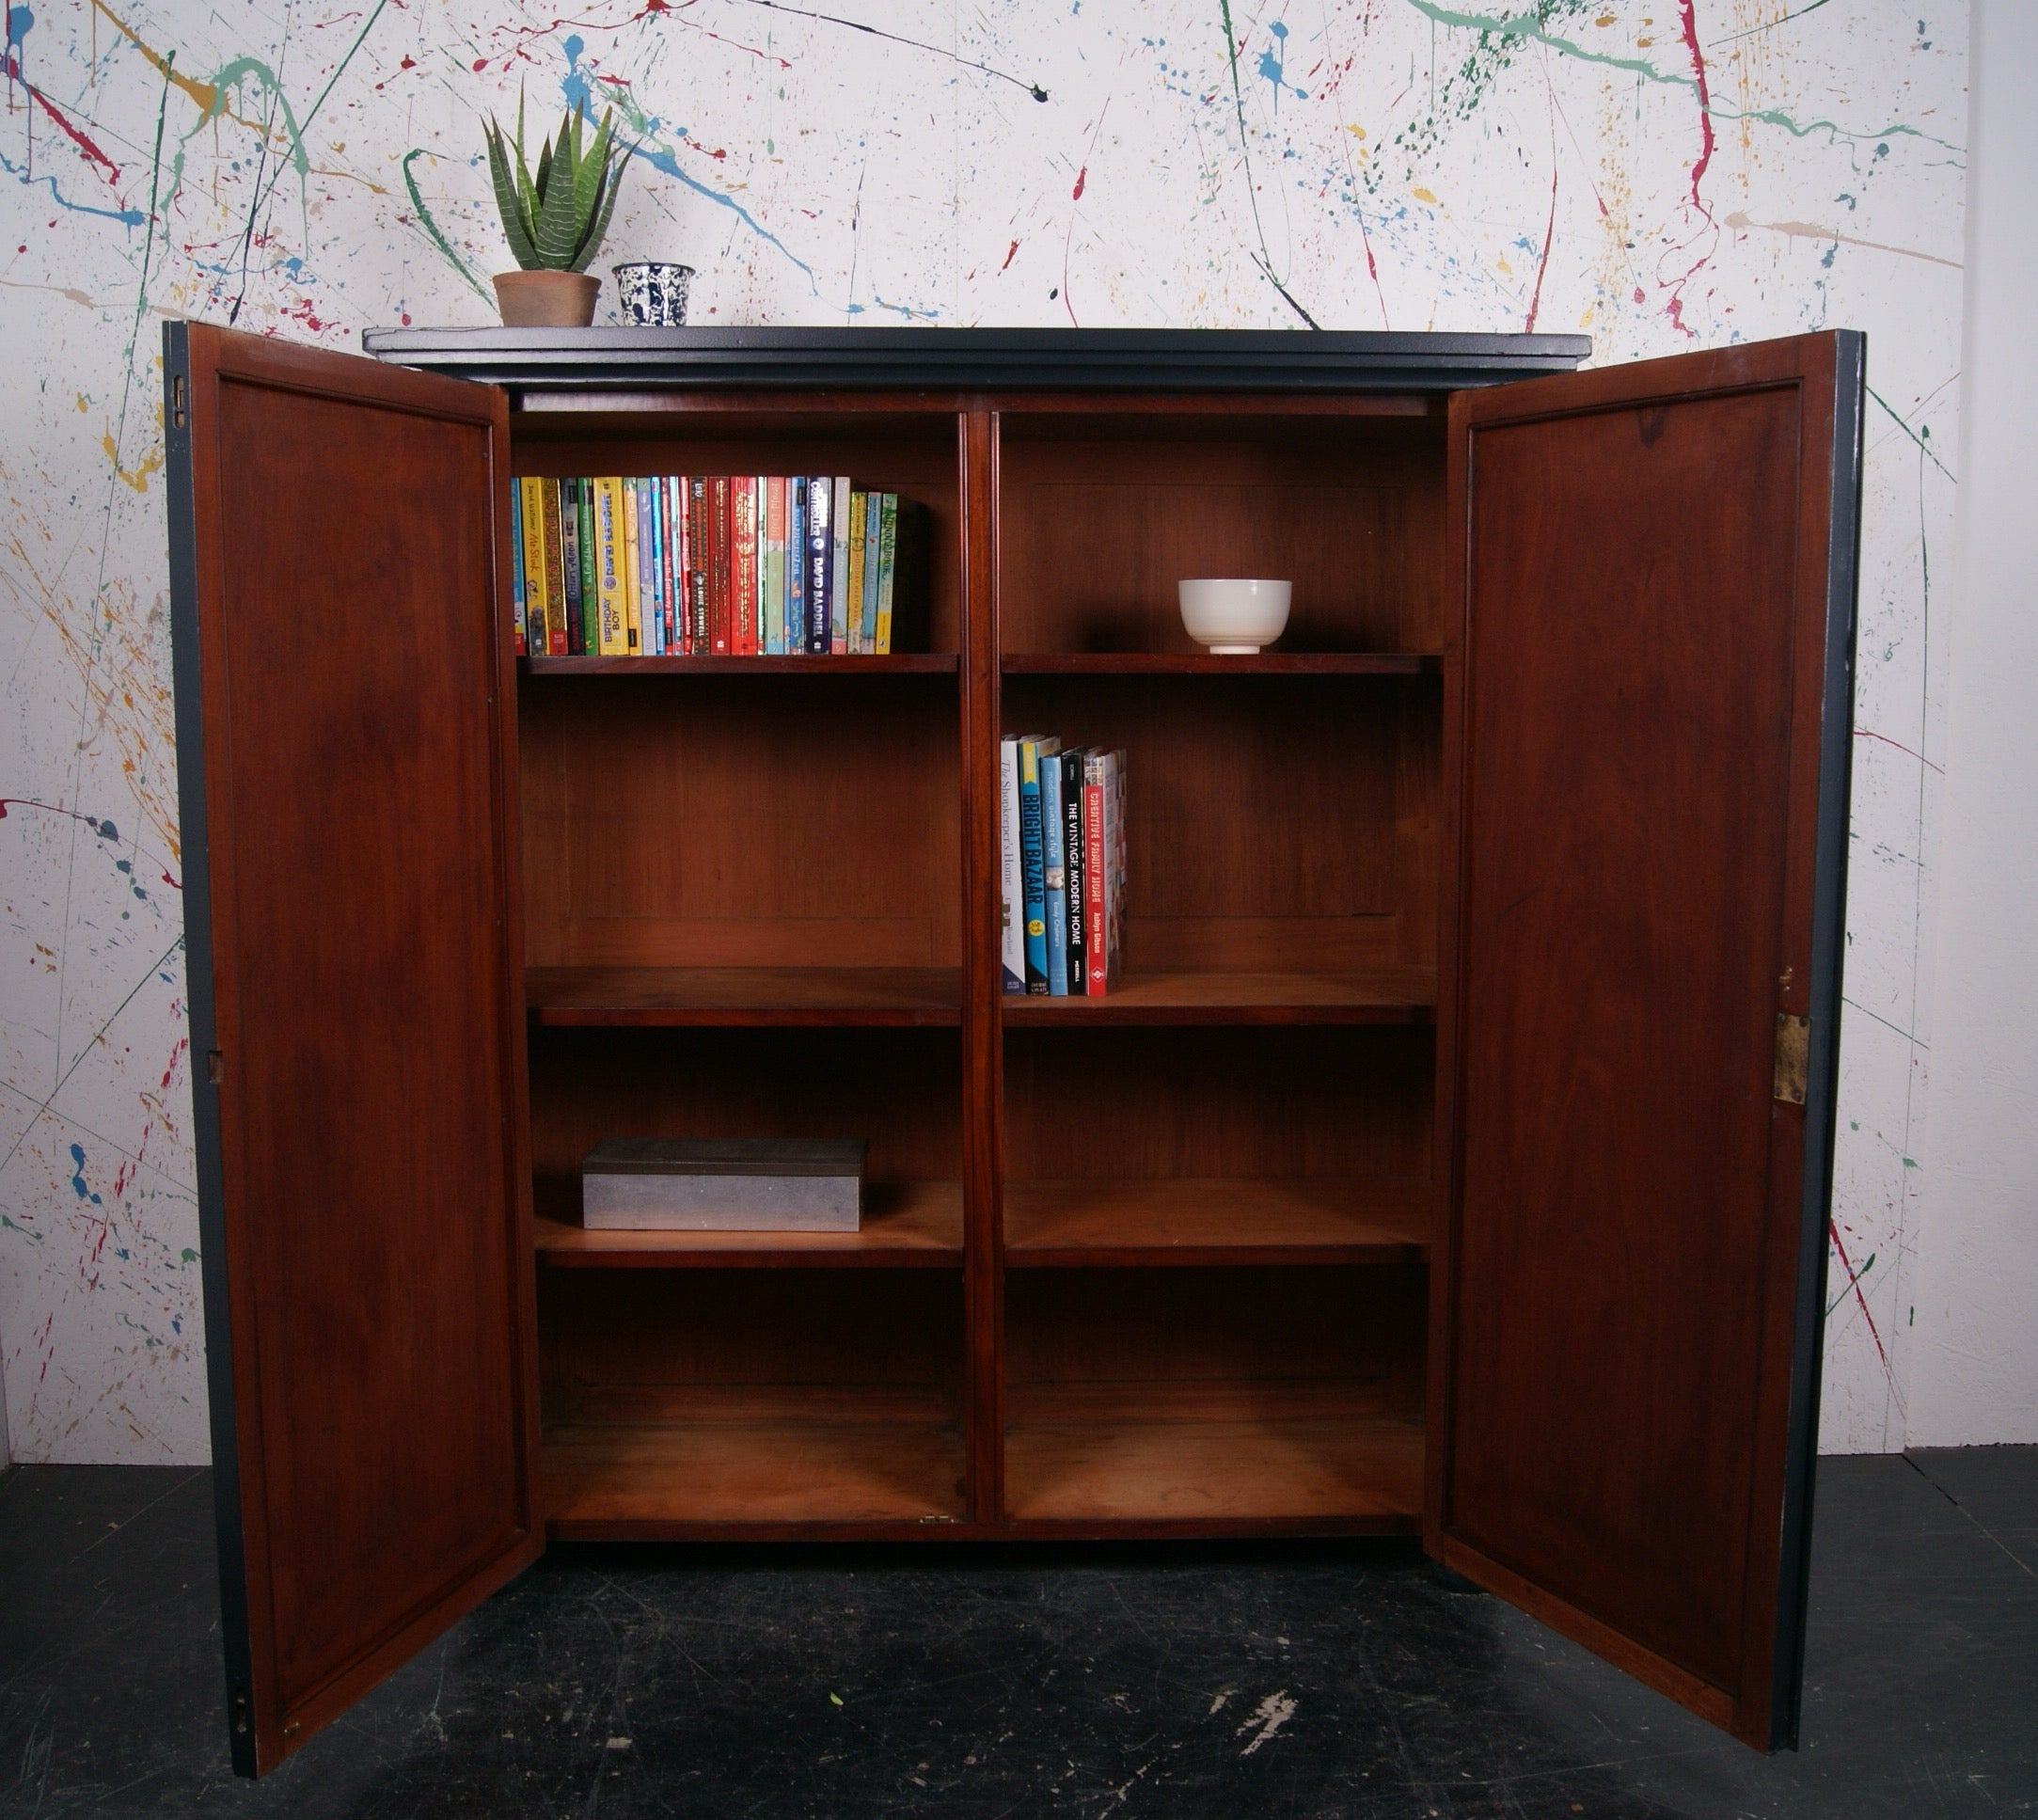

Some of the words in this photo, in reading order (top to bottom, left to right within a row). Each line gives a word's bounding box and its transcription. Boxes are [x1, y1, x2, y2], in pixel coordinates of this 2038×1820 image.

[601, 493, 613, 542] BADDIEL
[810, 482, 821, 536] CONTROLLER
[529, 533, 539, 547] Mr
[882, 514, 895, 551] JUNGLE
[530, 548, 541, 573] Stink
[566, 542, 577, 567] Moon
[603, 545, 614, 577] DAVID
[881, 552, 893, 575] BOOK
[813, 557, 824, 589] DAVID
[603, 598, 613, 643] BIRTHDAY
[611, 609, 620, 631] BOY
[813, 591, 824, 638] BADDIEL
[1002, 760, 1012, 779] The
[1048, 771, 1057, 803] modern
[1002, 781, 1014, 851] Shopkeeper's
[1022, 794, 1041, 847] BRIGHT
[1047, 805, 1058, 839] vintage
[1068, 802, 1078, 820] THE
[1090, 792, 1100, 839] CREATIVE
[1049, 840, 1059, 860] style
[1068, 822, 1079, 867] VINTAGE
[1091, 842, 1101, 875] FAMILY
[1004, 853, 1015, 887] Home
[1024, 849, 1043, 904] BAZAAR
[1070, 870, 1081, 913] MODERN
[1092, 877, 1101, 904] HOME
[1052, 902, 1061, 919] Emily
[1093, 912, 1102, 932] Ashlyn
[1071, 916, 1082, 945] HOME
[1094, 933, 1102, 955] Gibson
